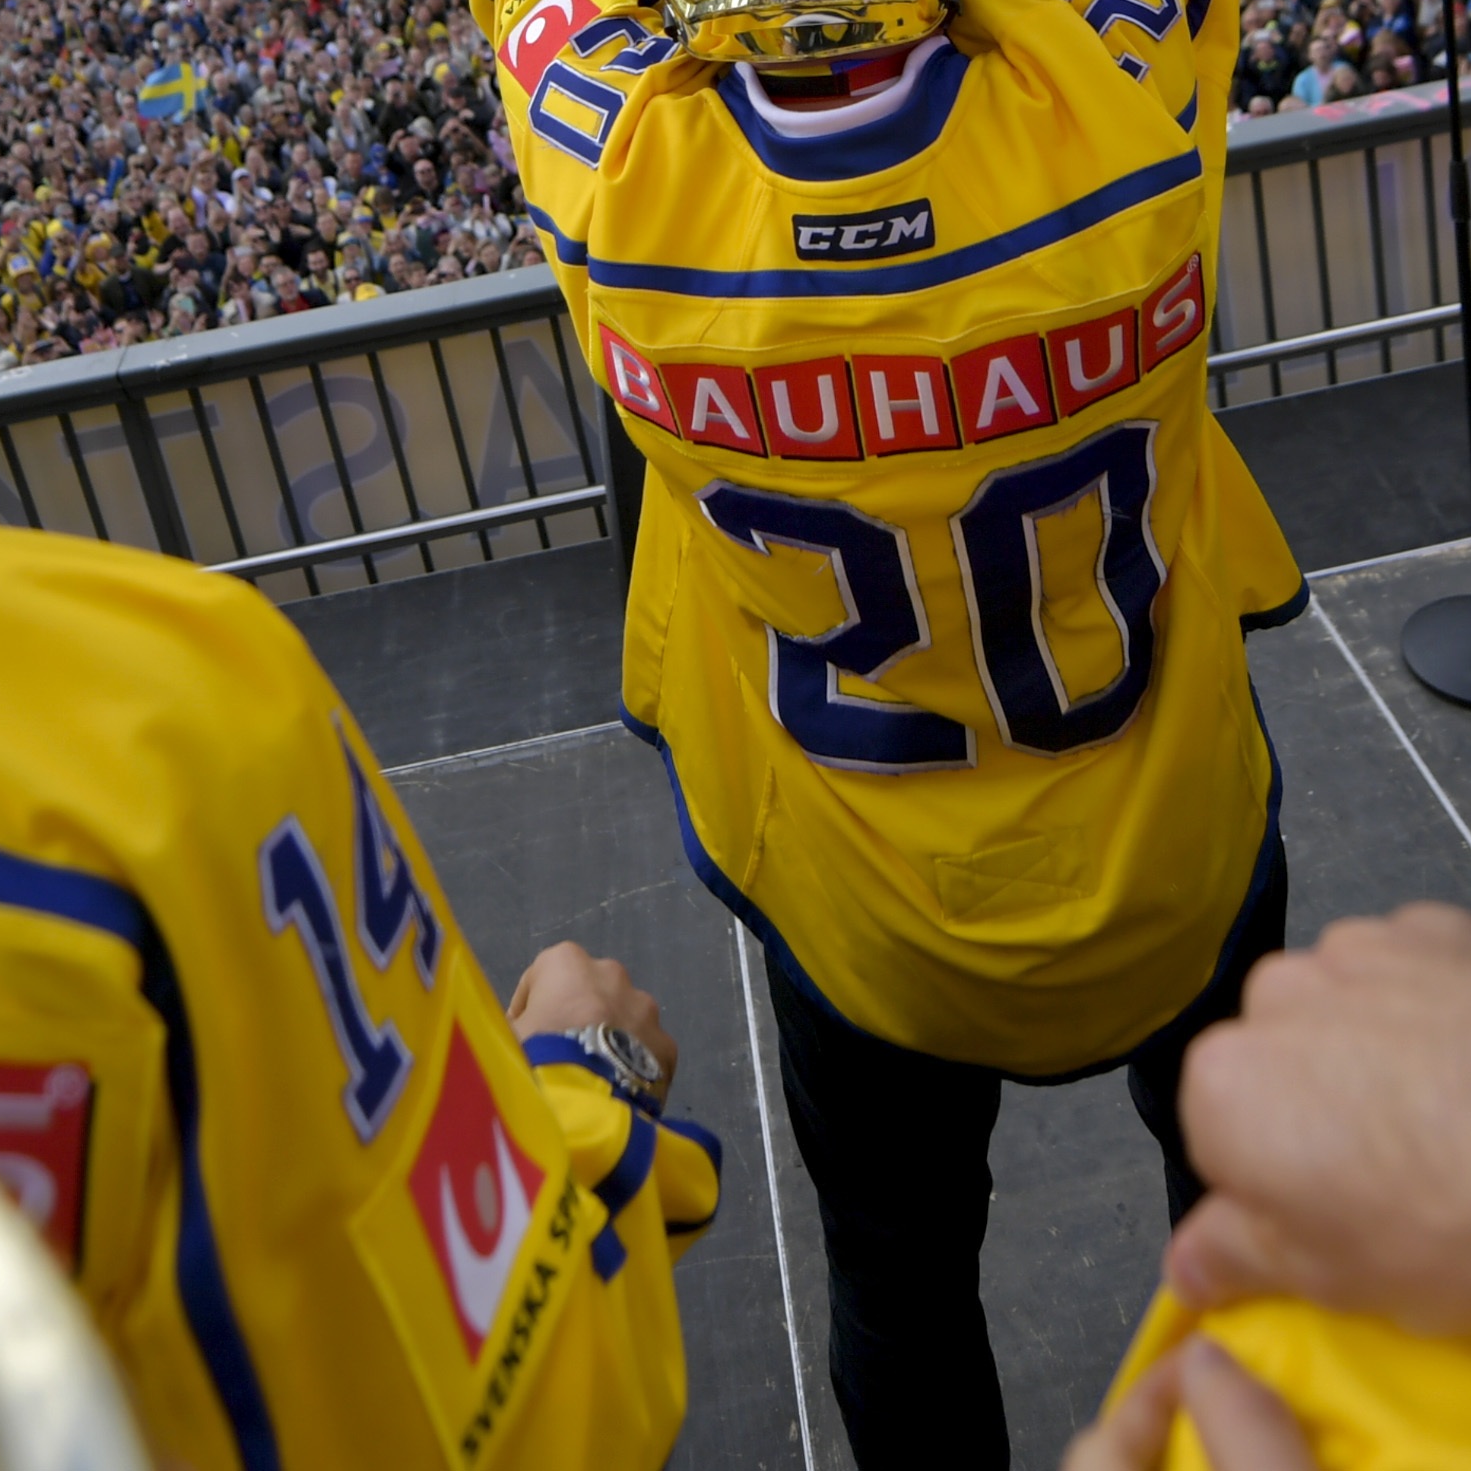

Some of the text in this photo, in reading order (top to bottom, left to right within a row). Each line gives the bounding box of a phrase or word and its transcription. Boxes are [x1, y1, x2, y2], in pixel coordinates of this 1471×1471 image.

[797, 209, 931, 252] CCM
[612, 272, 1201, 444] BAUHAUS
[694, 419, 1167, 775] 20
[257, 708, 444, 1144] 14
[458, 1263, 558, 1460] SVENSKA
